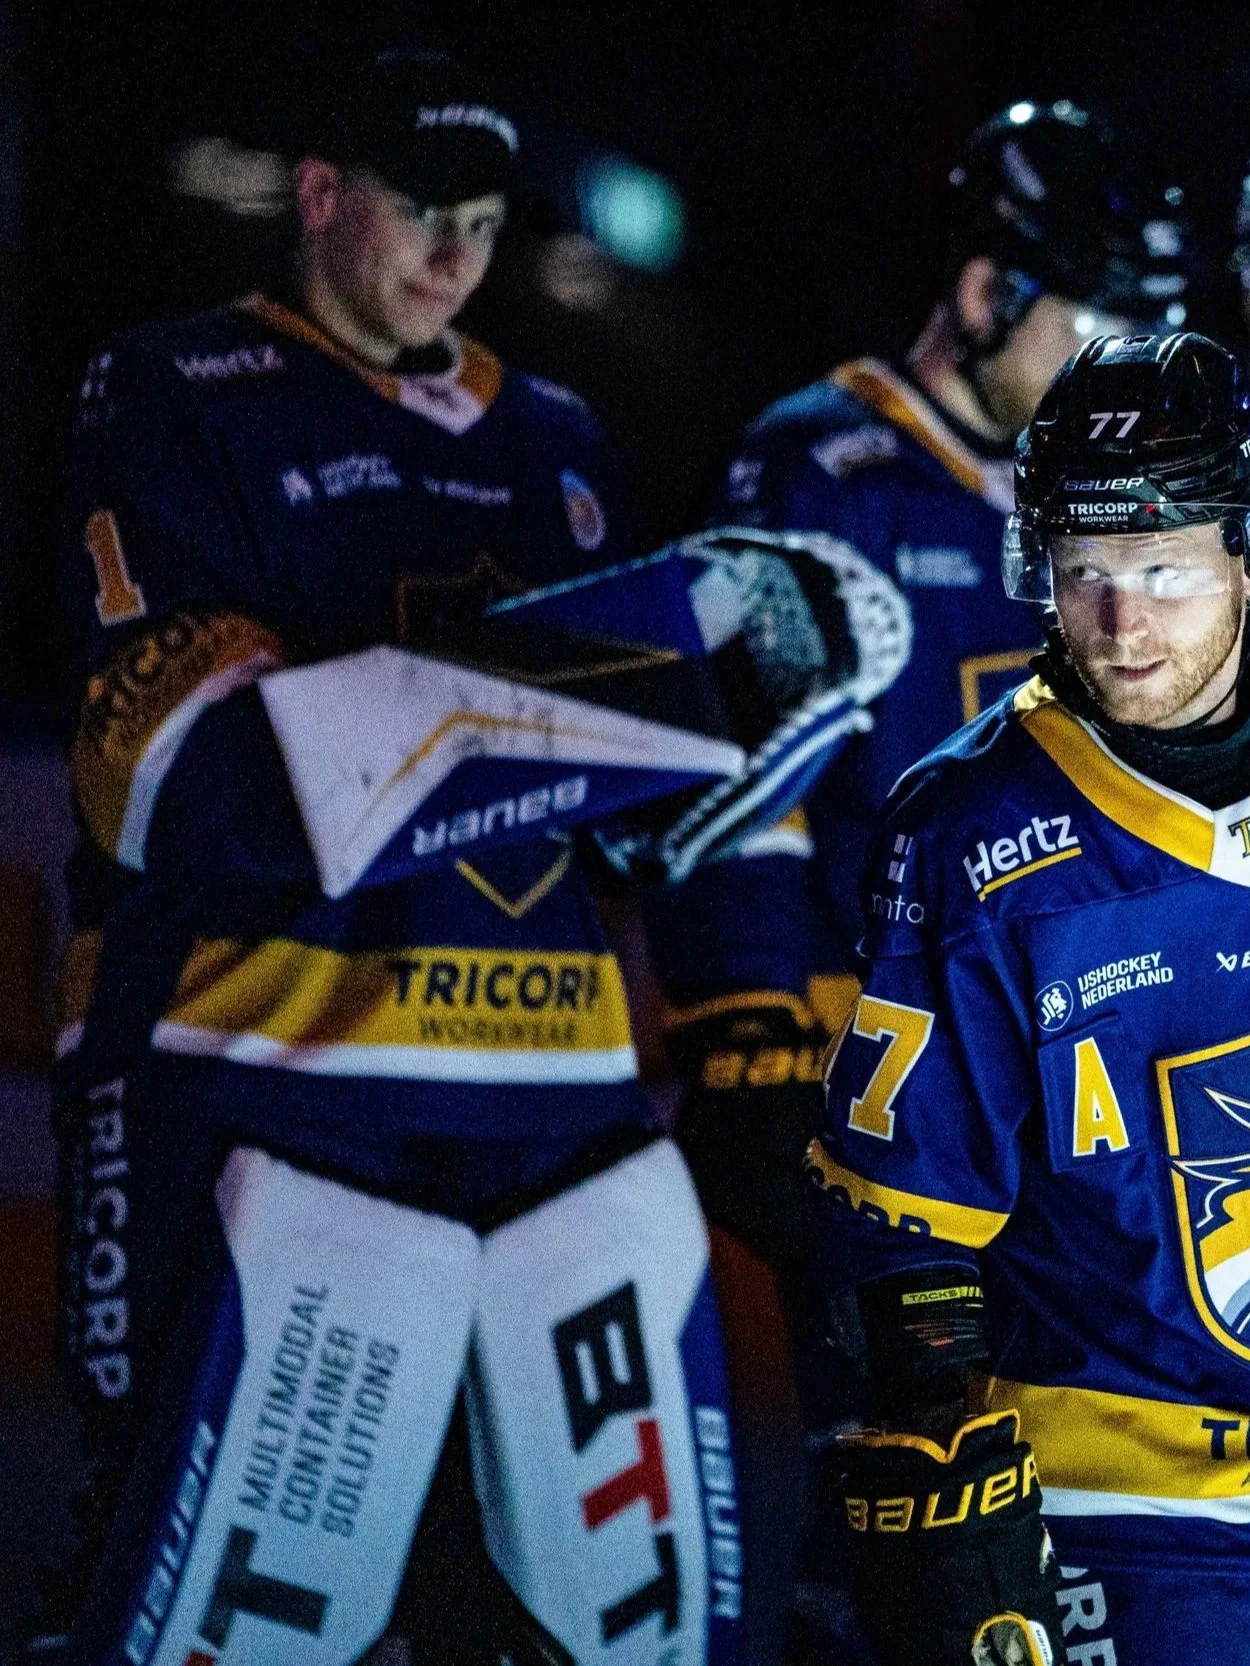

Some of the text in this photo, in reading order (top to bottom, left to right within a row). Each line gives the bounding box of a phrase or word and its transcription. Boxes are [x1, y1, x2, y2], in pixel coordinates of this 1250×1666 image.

[1088, 411, 1141, 439] 77
[1068, 502, 1139, 515] TRICORP
[1079, 515, 1129, 523] WORKWEAR
[962, 814, 1080, 892] Hertz
[1080, 966, 1174, 1011] NEDERLAND
[823, 995, 935, 1142] 7
[1073, 1036, 1131, 1158] A
[909, 1290, 958, 1303] TACKS
[237, 1283, 330, 1512] MULTIMODAL
[278, 1325, 358, 1526] CONTAINER
[319, 1339, 400, 1538] SOLUTIONS
